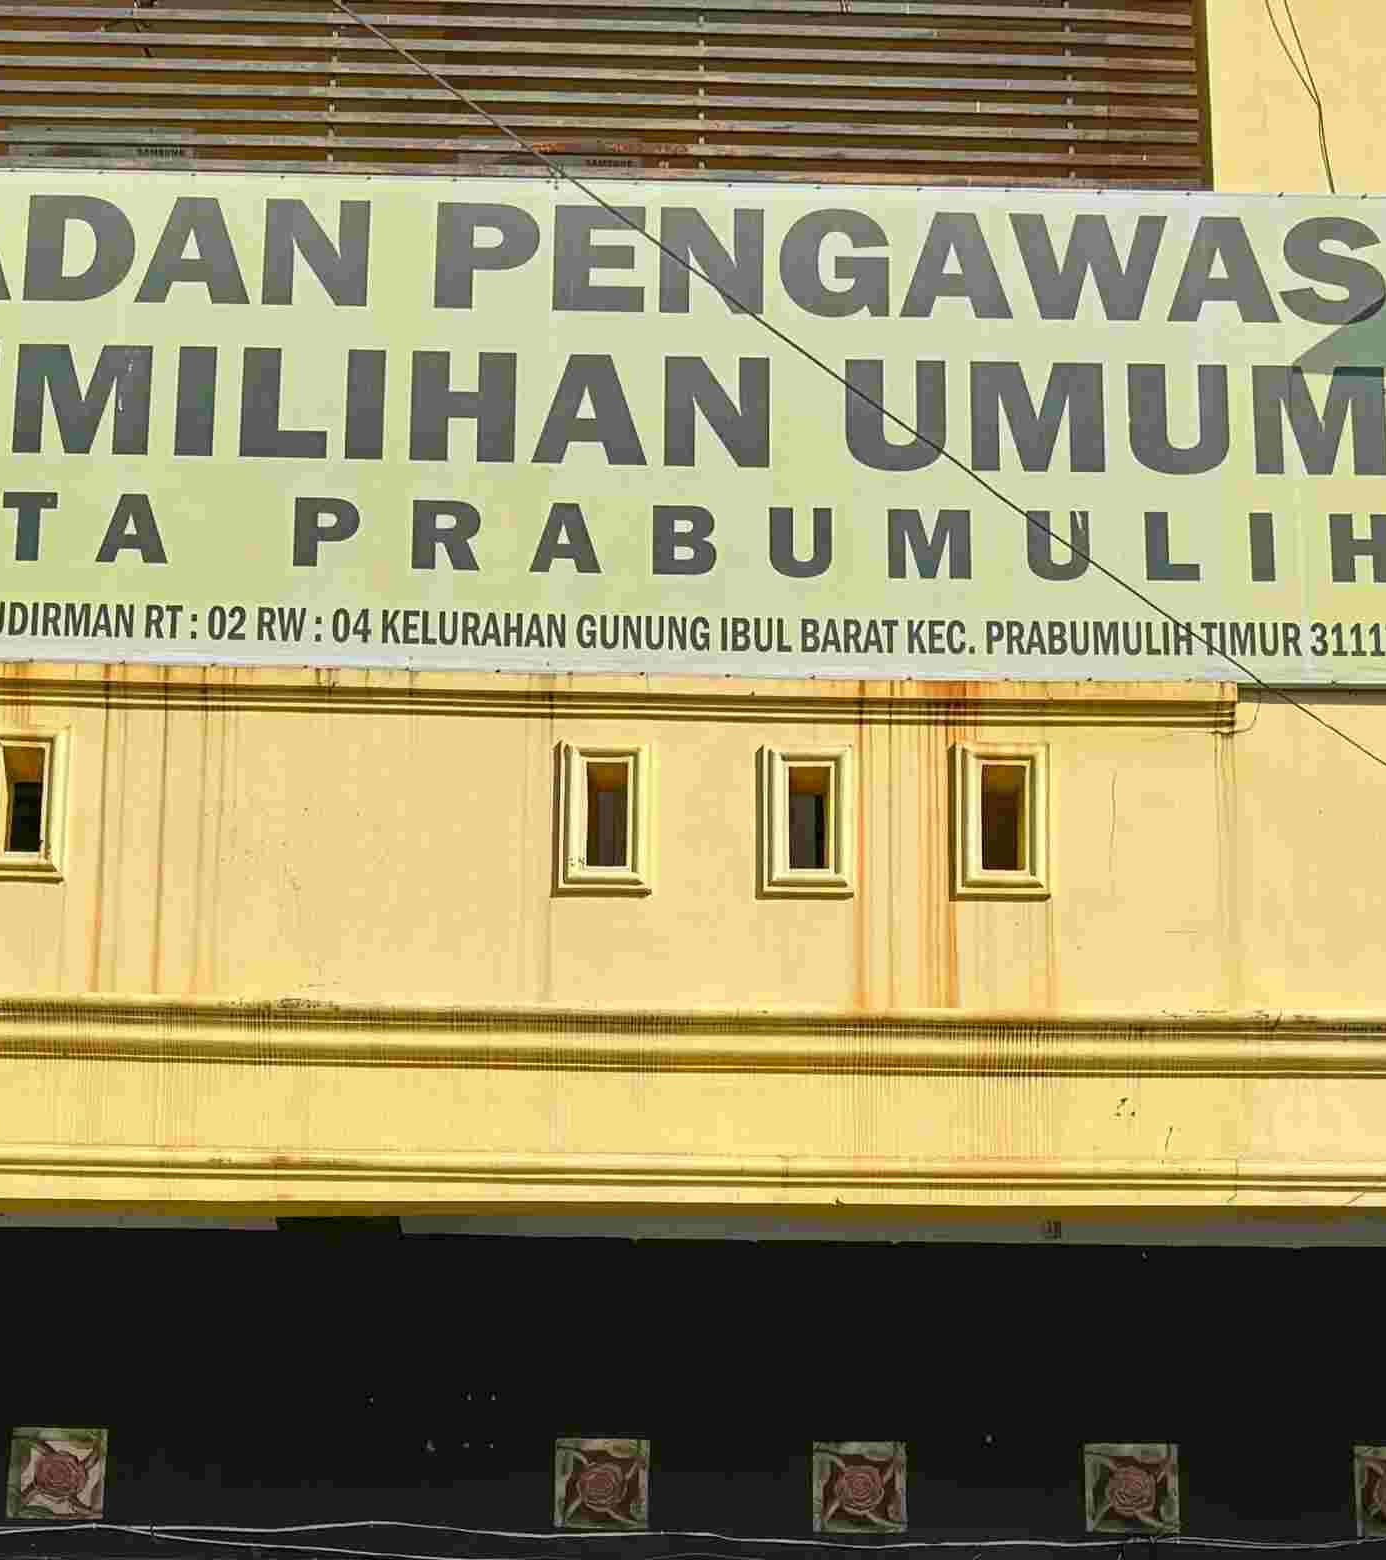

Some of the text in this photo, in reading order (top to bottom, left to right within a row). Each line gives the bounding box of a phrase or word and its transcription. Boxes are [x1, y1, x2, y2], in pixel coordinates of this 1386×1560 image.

[435, 203, 1386, 325] PENGAWAS
[208, 605, 246, 640] 02
[332, 607, 372, 643] 04
[382, 609, 566, 648] KELURAHAN
[576, 614, 710, 651] GUNUNG
[721, 617, 792, 652] IBUL
[801, 618, 899, 654] BARAT
[907, 619, 976, 655] KEC.
[986, 620, 1192, 656] PRABUMULIH
[1201, 622, 1302, 657] TIMUR
